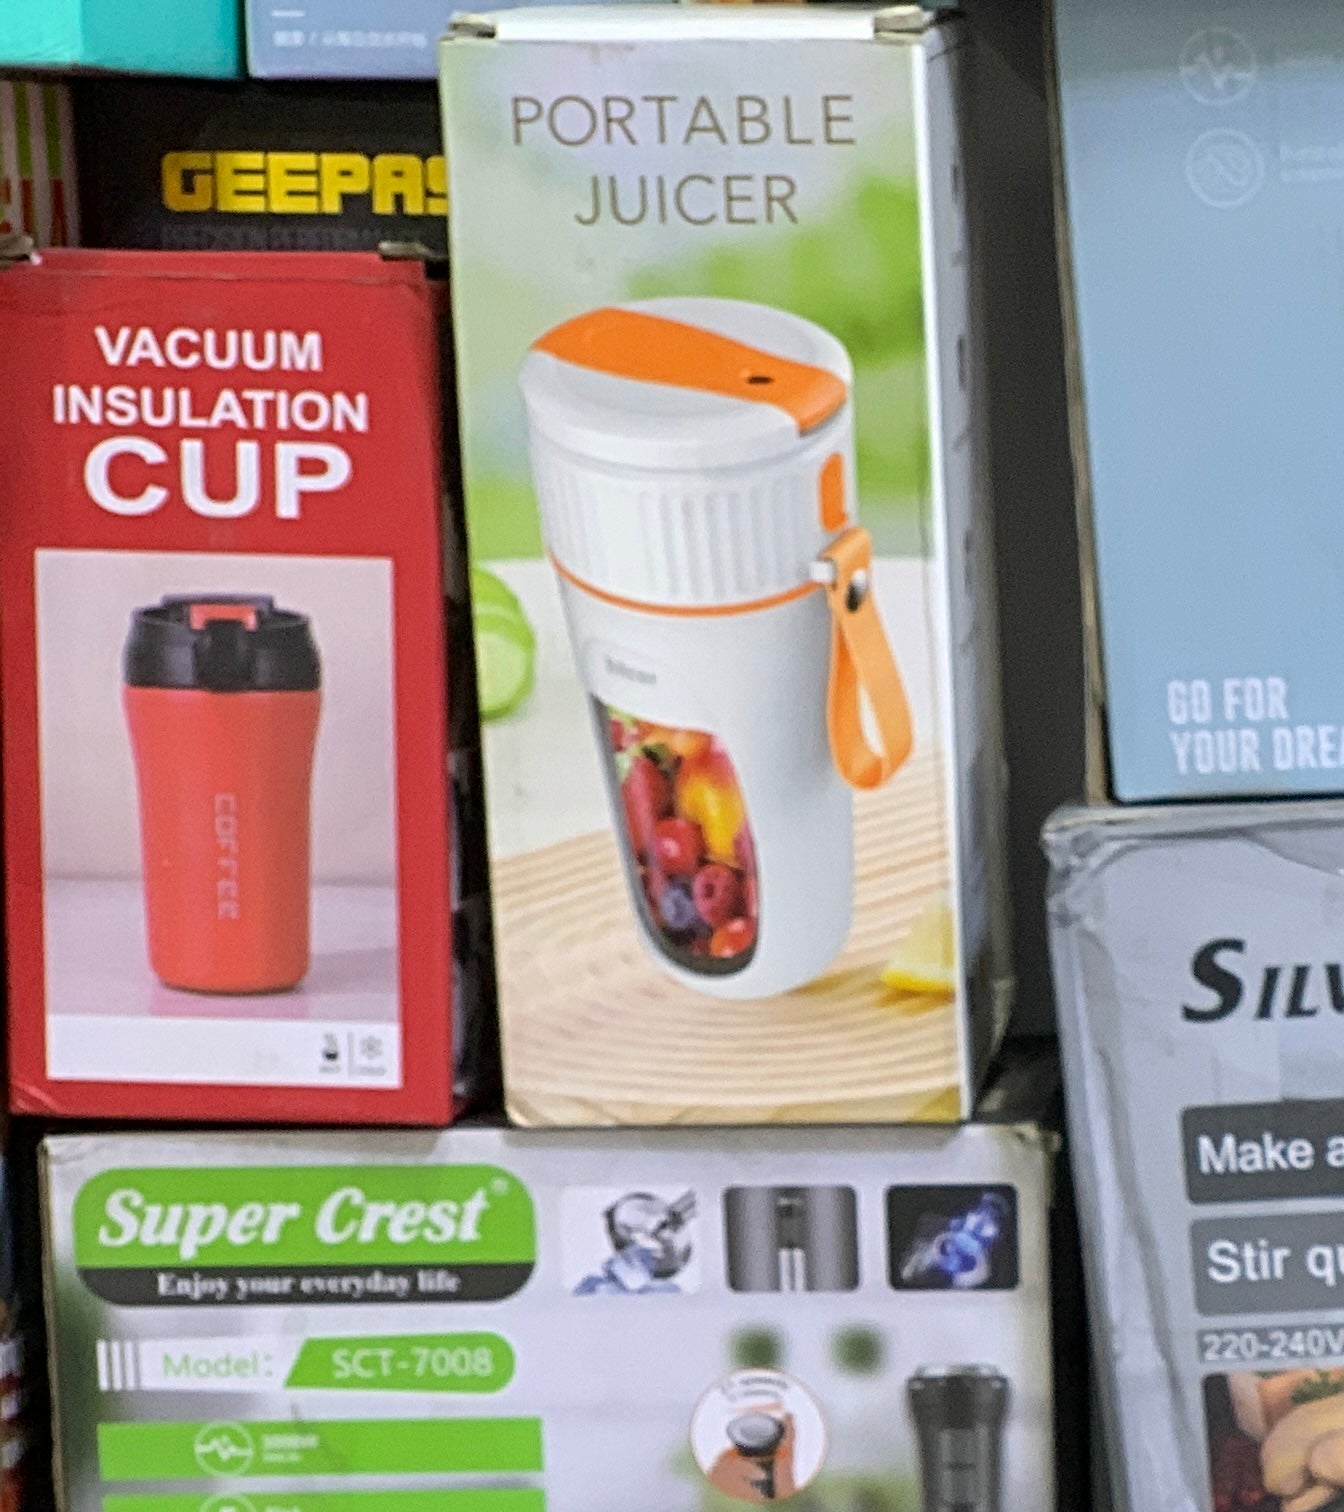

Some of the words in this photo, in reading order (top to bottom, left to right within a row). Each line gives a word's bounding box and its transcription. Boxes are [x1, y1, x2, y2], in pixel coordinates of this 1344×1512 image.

[512, 94, 857, 149] PORTABLE
[574, 173, 800, 228] JUICER
[95, 326, 323, 371] VACUUM
[53, 388, 369, 433] INSULATION
[83, 437, 354, 520] CUP
[1167, 680, 1212, 725] GO
[1223, 677, 1289, 722] FOR
[1168, 728, 1262, 775] YOUR
[213, 793, 240, 920] COFFEE
[1198, 1131, 1315, 1175] Make
[99, 1189, 302, 1262] Super
[315, 1186, 490, 1244] Crest
[156, 1271, 228, 1300] Enjoy
[236, 1275, 296, 1300] your
[300, 1270, 409, 1298] everyday
[417, 1269, 460, 1293] life
[1206, 1238, 1290, 1284] Stir
[162, 1350, 274, 1379] Model:
[332, 1347, 495, 1380] SCT-7008
